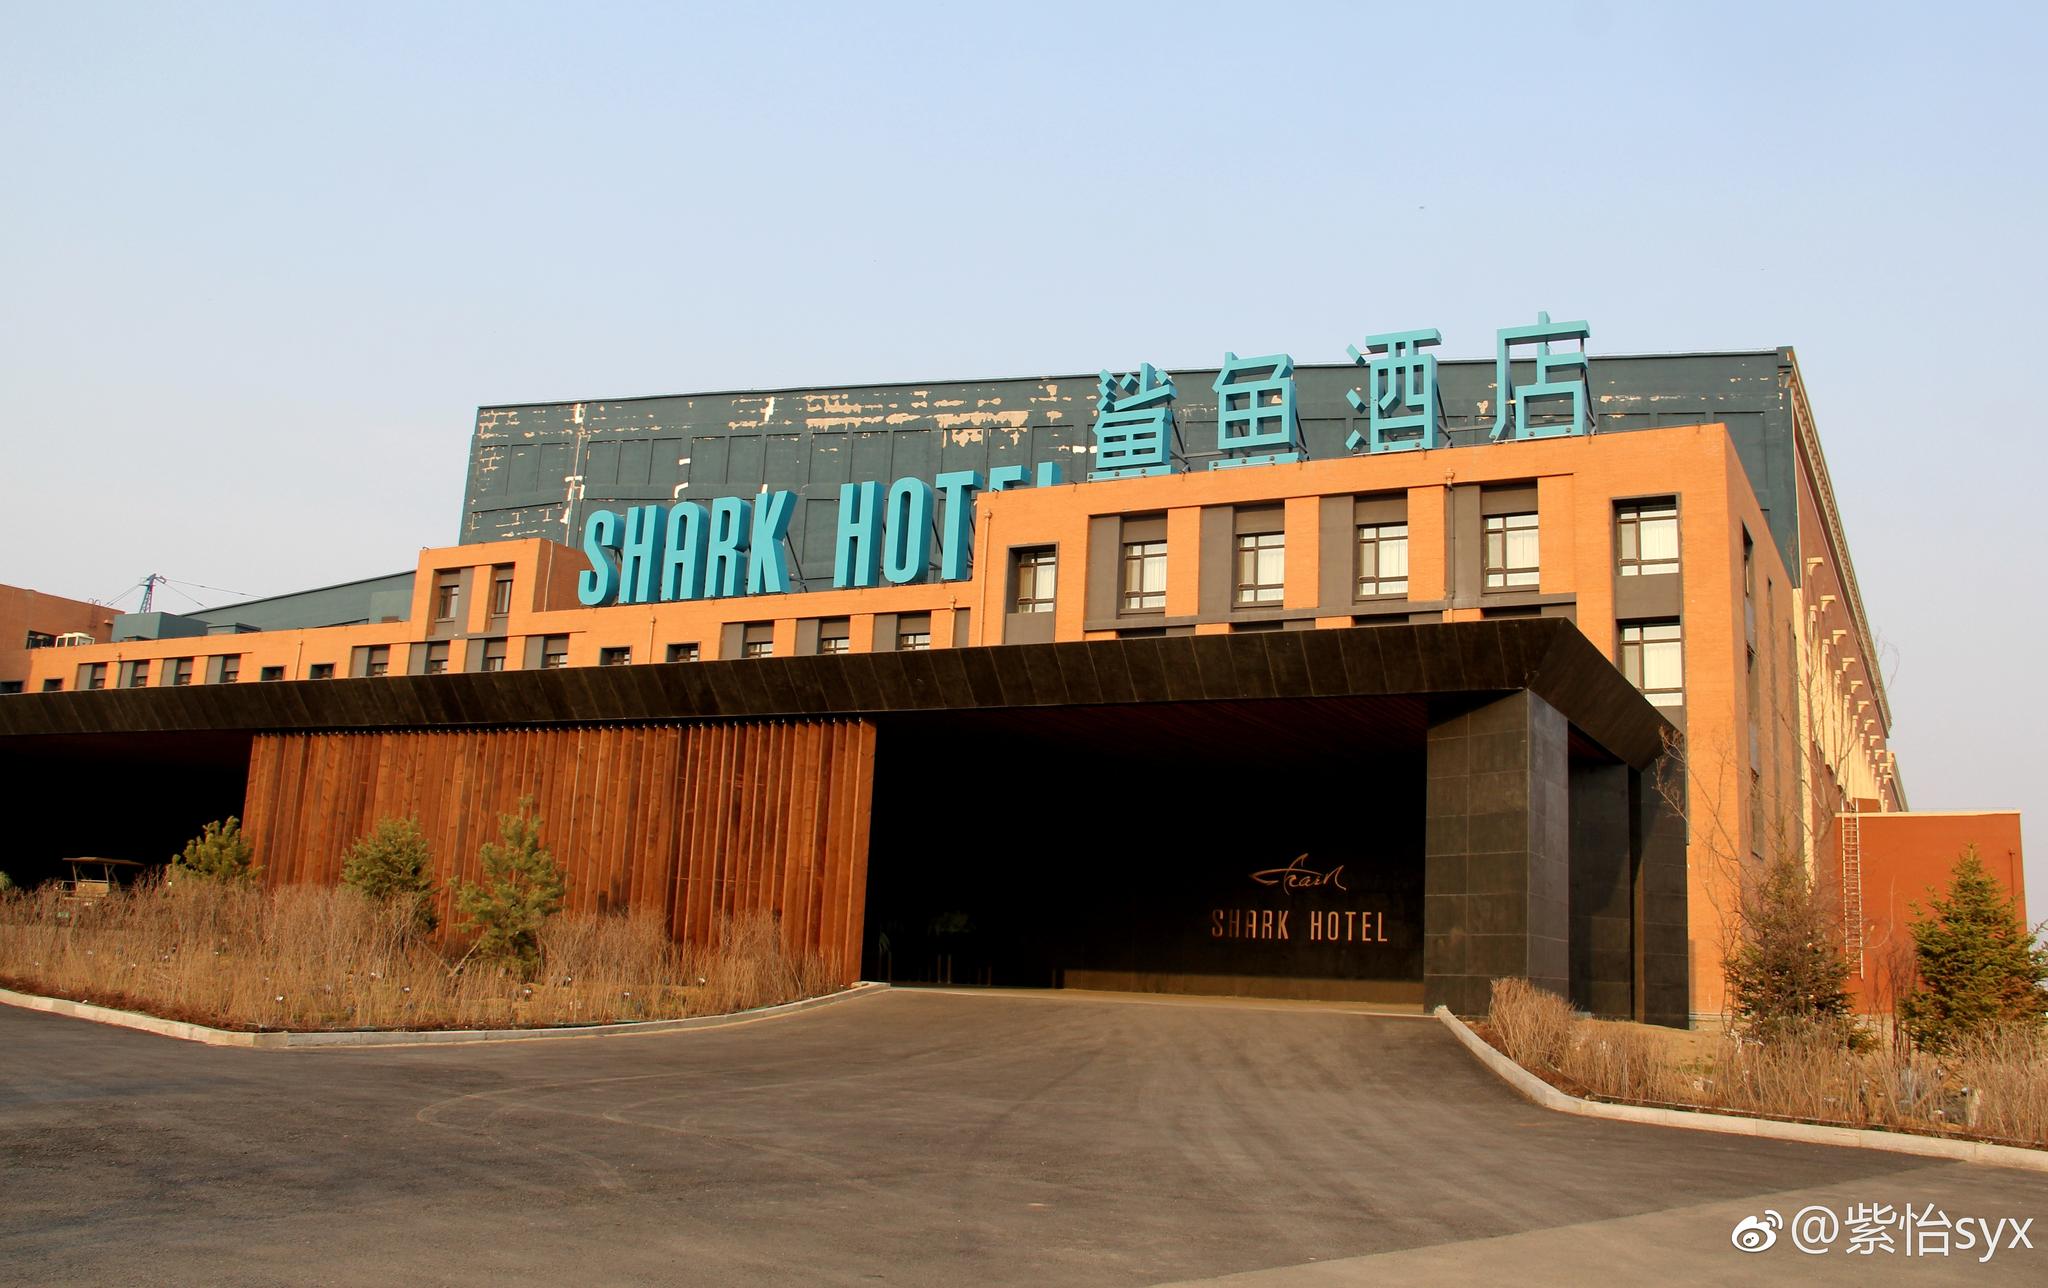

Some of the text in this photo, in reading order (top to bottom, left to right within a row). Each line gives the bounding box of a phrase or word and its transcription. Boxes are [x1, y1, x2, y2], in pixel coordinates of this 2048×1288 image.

[1088, 311, 1590, 481] 鲨鱼酒店
[578, 461, 1063, 606] SHARK HOT
[1211, 908, 1389, 943] SHARK HOTEL
